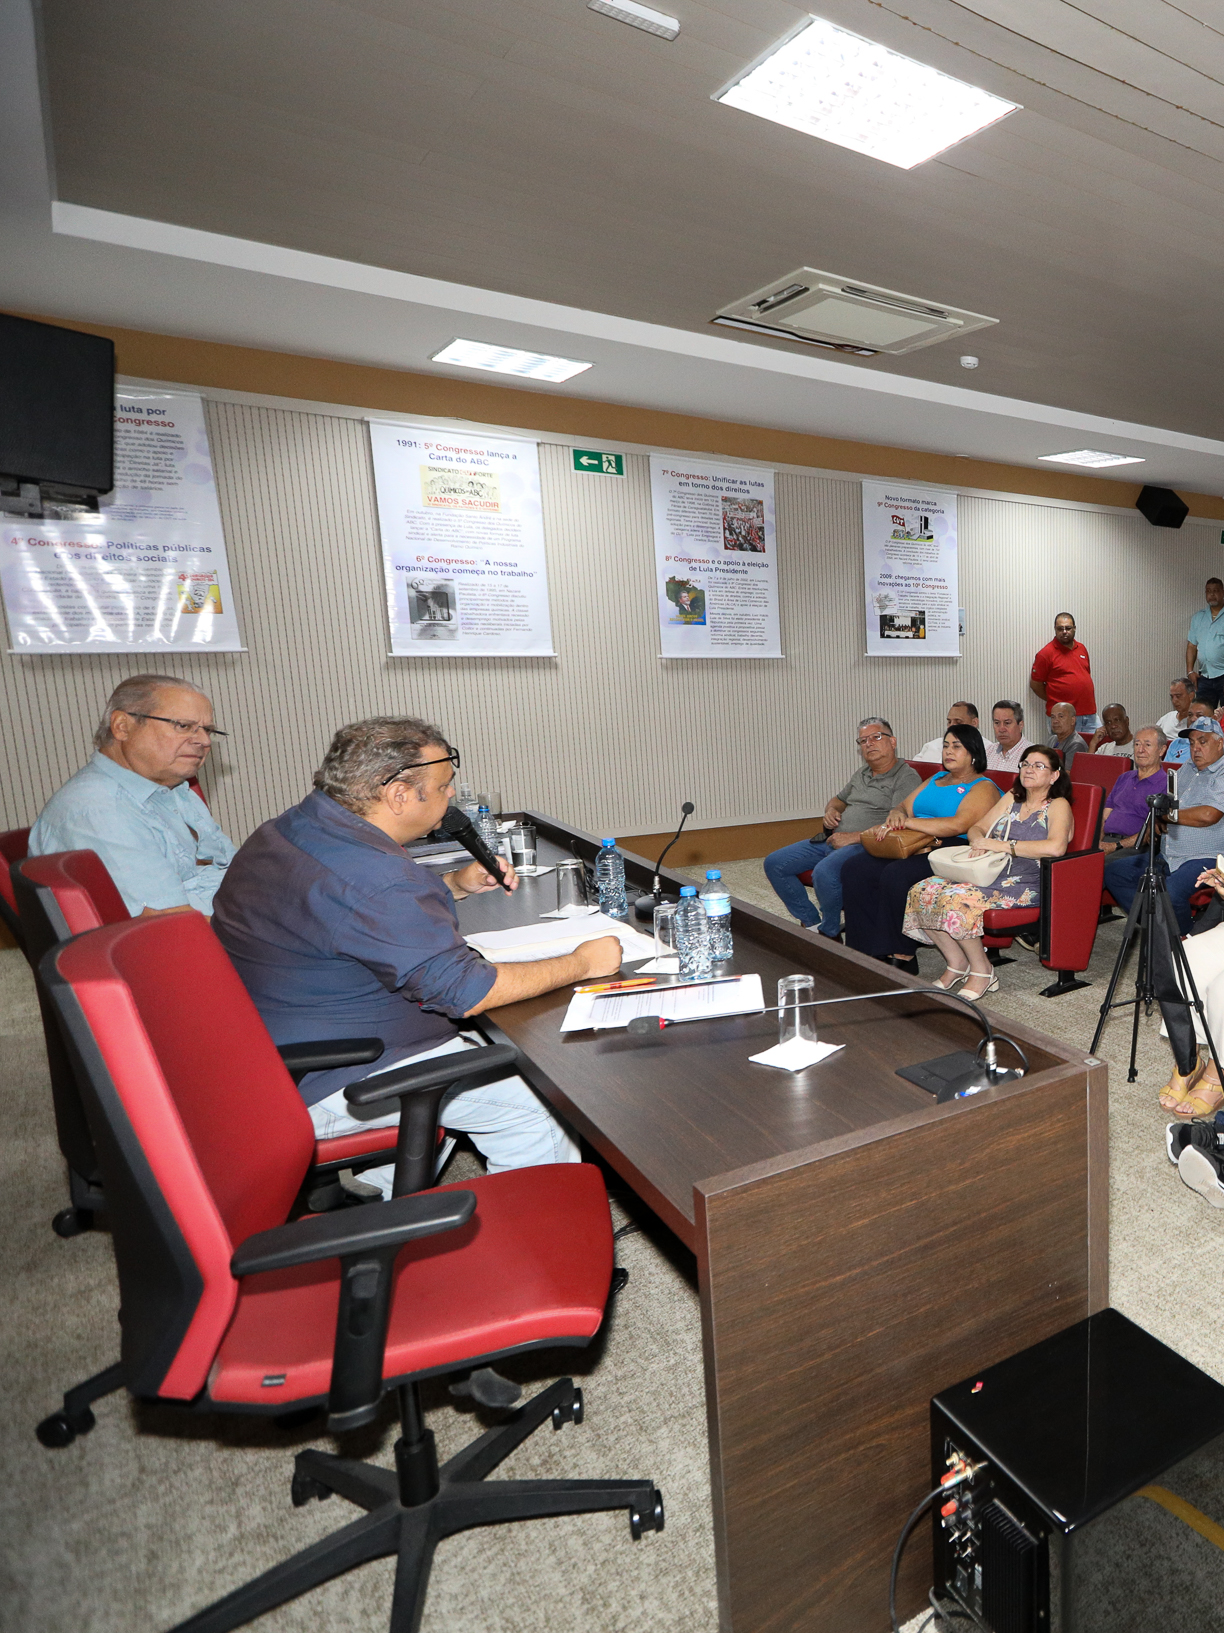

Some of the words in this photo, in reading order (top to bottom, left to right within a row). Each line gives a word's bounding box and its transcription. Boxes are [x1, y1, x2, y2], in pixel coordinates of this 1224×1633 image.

[120, 404, 143, 414] luta
[397, 440, 421, 448] 1991:
[436, 444, 485, 455] Congresso
[486, 450, 510, 459] lança
[428, 453, 454, 462] Carta
[470, 458, 490, 466] ABC
[428, 466, 460, 474] SINDICATO
[670, 470, 710, 480] Congresso:
[712, 476, 738, 485] Unificar
[749, 480, 765, 488] lutas
[725, 486, 750, 494] direitos
[427, 496, 459, 505] VAMOS
[462, 499, 499, 509] SACUDIR
[884, 502, 913, 511] Congresso
[921, 506, 945, 515] categoria
[894, 517, 904, 525] CUT
[106, 541, 160, 551] Políticas
[162, 544, 211, 554] públicas
[136, 554, 178, 563] sociais
[428, 556, 478, 566] Congresso:
[674, 556, 710, 564] Congresso
[395, 565, 450, 574] organização
[500, 570, 538, 578] trabalho"
[714, 567, 749, 576] Presidente
